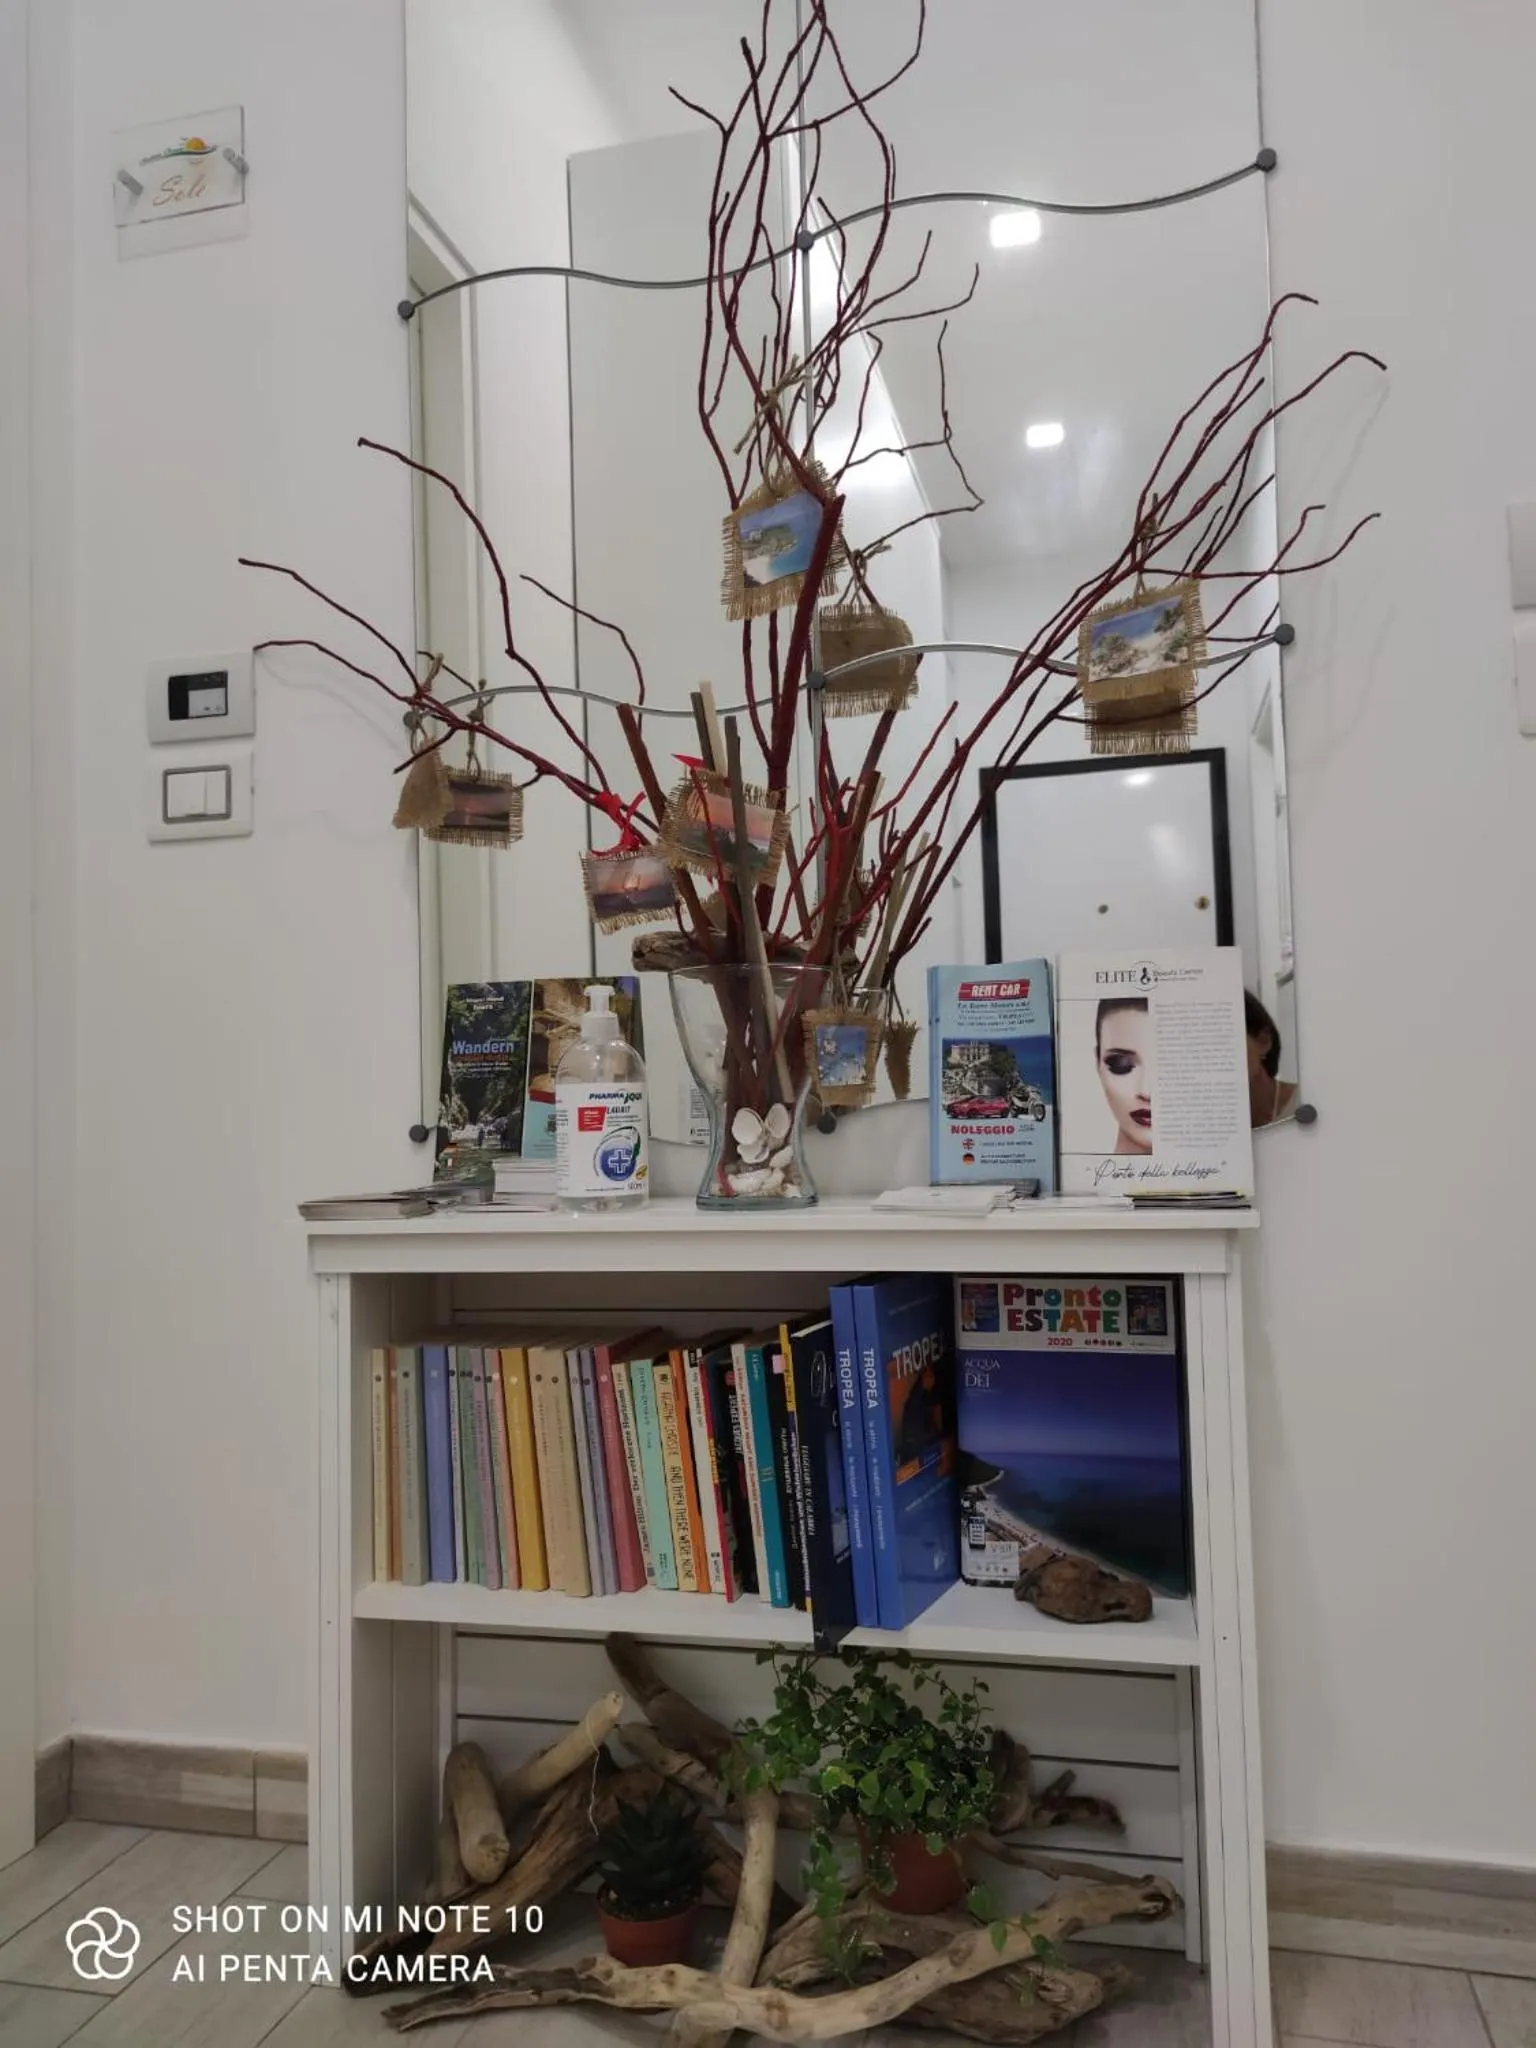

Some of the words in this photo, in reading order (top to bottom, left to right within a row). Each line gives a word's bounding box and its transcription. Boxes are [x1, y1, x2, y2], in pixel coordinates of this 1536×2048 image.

[1095, 970, 1136, 983] ELITE
[971, 984, 998, 997] RENT
[1000, 983, 1021, 996] CAR
[452, 1040, 515, 1055] Wandern
[951, 1124, 1015, 1135] NOLEGGIO
[1003, 1283, 1122, 1308] Pronto
[1007, 1308, 1121, 1334] ESTATE
[1048, 1337, 1073, 1347] 2020
[964, 1357, 1001, 1371] ACQUA
[839, 1349, 854, 1409] TROPEA
[863, 1348, 879, 1409] TROPEA
[672, 1486, 685, 1506] THEN
[675, 1508, 689, 1532] THERE
[678, 1534, 691, 1556] WERE
[681, 1558, 694, 1579] NONE
